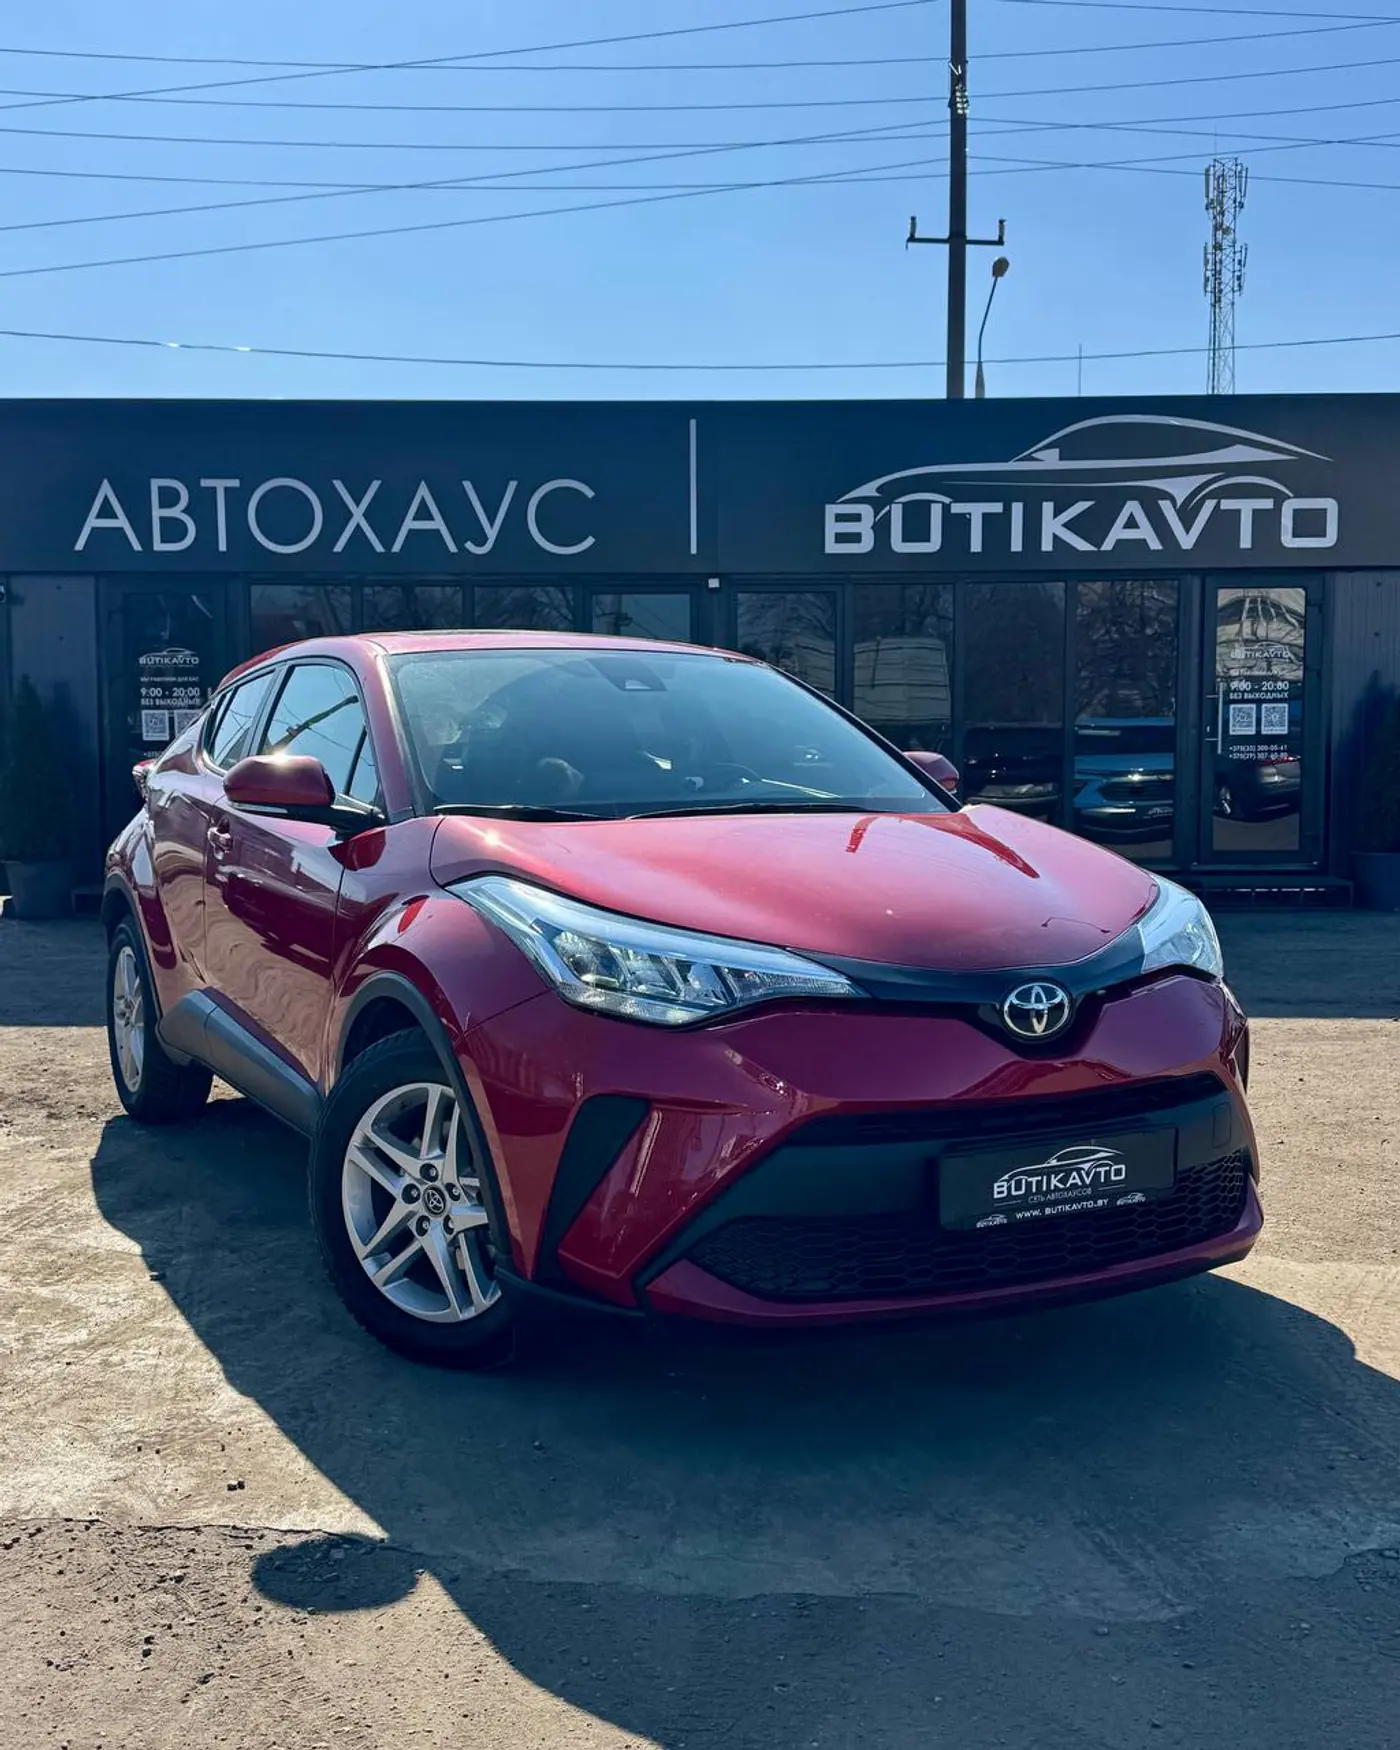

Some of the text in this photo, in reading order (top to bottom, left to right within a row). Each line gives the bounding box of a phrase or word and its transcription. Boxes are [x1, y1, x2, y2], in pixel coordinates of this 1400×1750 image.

[74, 478, 597, 556] АВТОХАУС
[824, 496, 1338, 554] BUTIKAVTO
[140, 687, 163, 697] 9:00
[172, 687, 200, 697] 20:00
[1229, 691, 1289, 700] БЕЗ ВЫХОДНЫХ
[1230, 680, 1251, 691] 9:00
[1261, 680, 1289, 691] 20:00
[993, 1164, 1126, 1199] BUTIKAVTO
